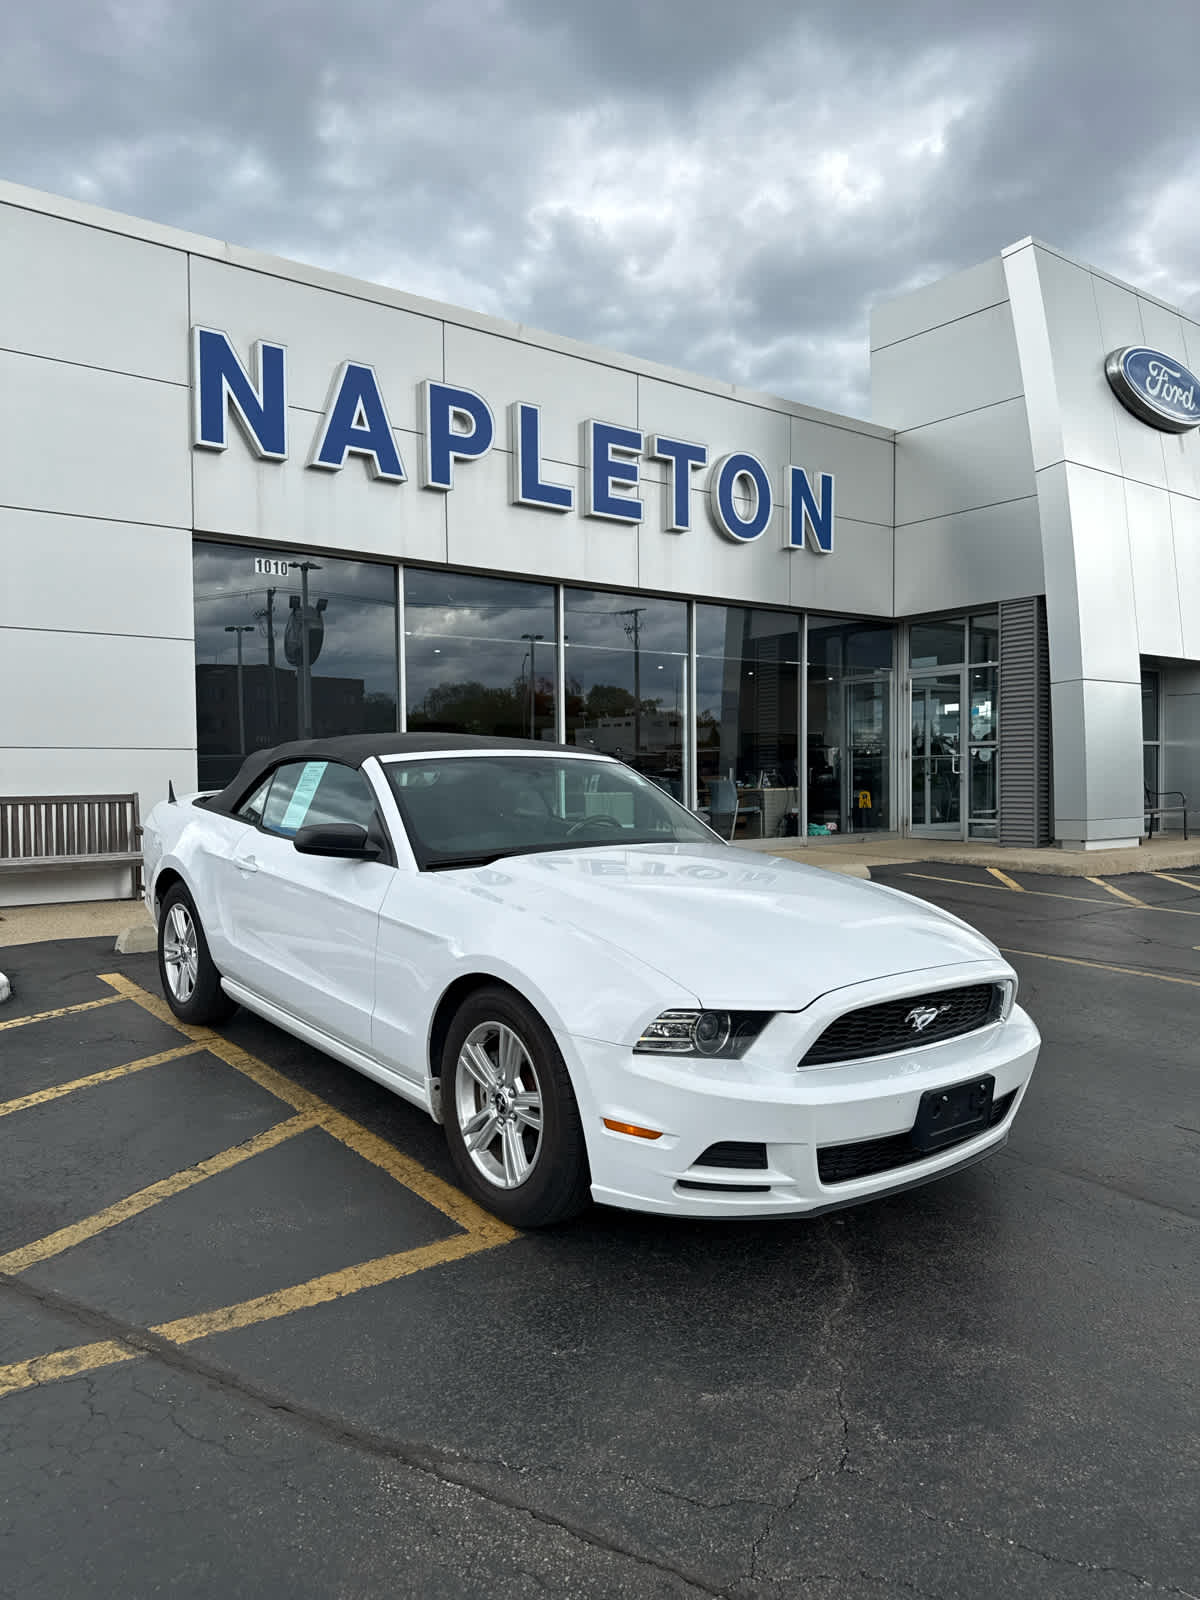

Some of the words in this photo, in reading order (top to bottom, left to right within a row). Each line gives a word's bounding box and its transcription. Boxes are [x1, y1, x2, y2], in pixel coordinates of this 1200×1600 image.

[1145, 360, 1196, 411] Ford
[192, 325, 835, 554] NAPLETON
[256, 559, 288, 576] 1010
